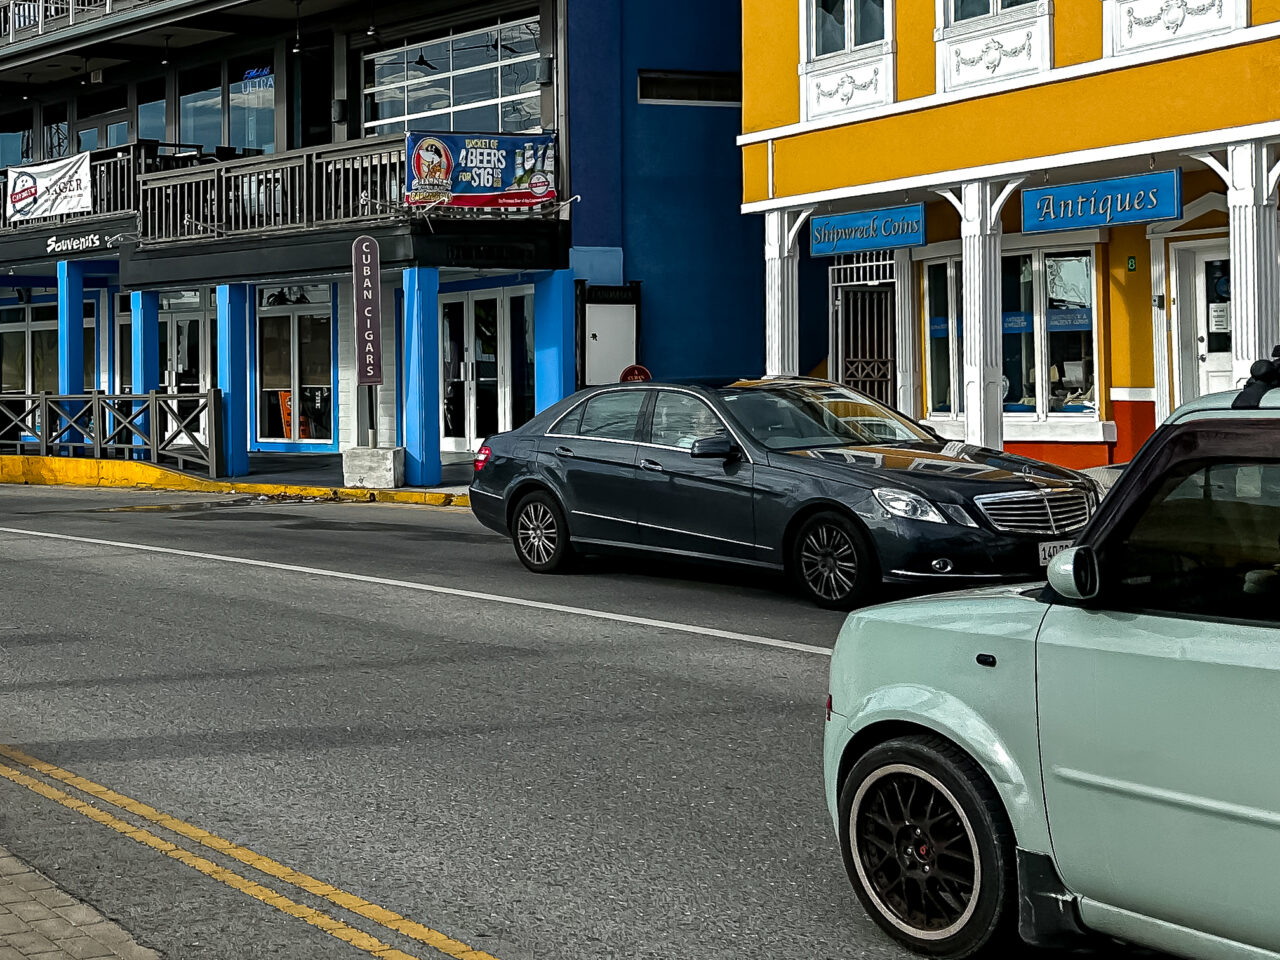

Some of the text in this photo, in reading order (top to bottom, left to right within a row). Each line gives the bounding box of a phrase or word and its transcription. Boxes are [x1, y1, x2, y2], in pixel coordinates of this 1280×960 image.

[241, 77, 274, 95] ULTRA
[459, 148, 506, 168] 4 BEERS
[459, 172, 472, 181] FOR
[471, 168, 493, 187] $16
[493, 169, 502, 178] US
[1036, 187, 1159, 224] Antiques
[813, 217, 920, 250] Shipwreck Coins
[46, 234, 100, 254] Souvenirs
[362, 241, 373, 300] CUBAN
[1128, 258, 1136, 270] 8
[364, 306, 375, 376] CIGARS
